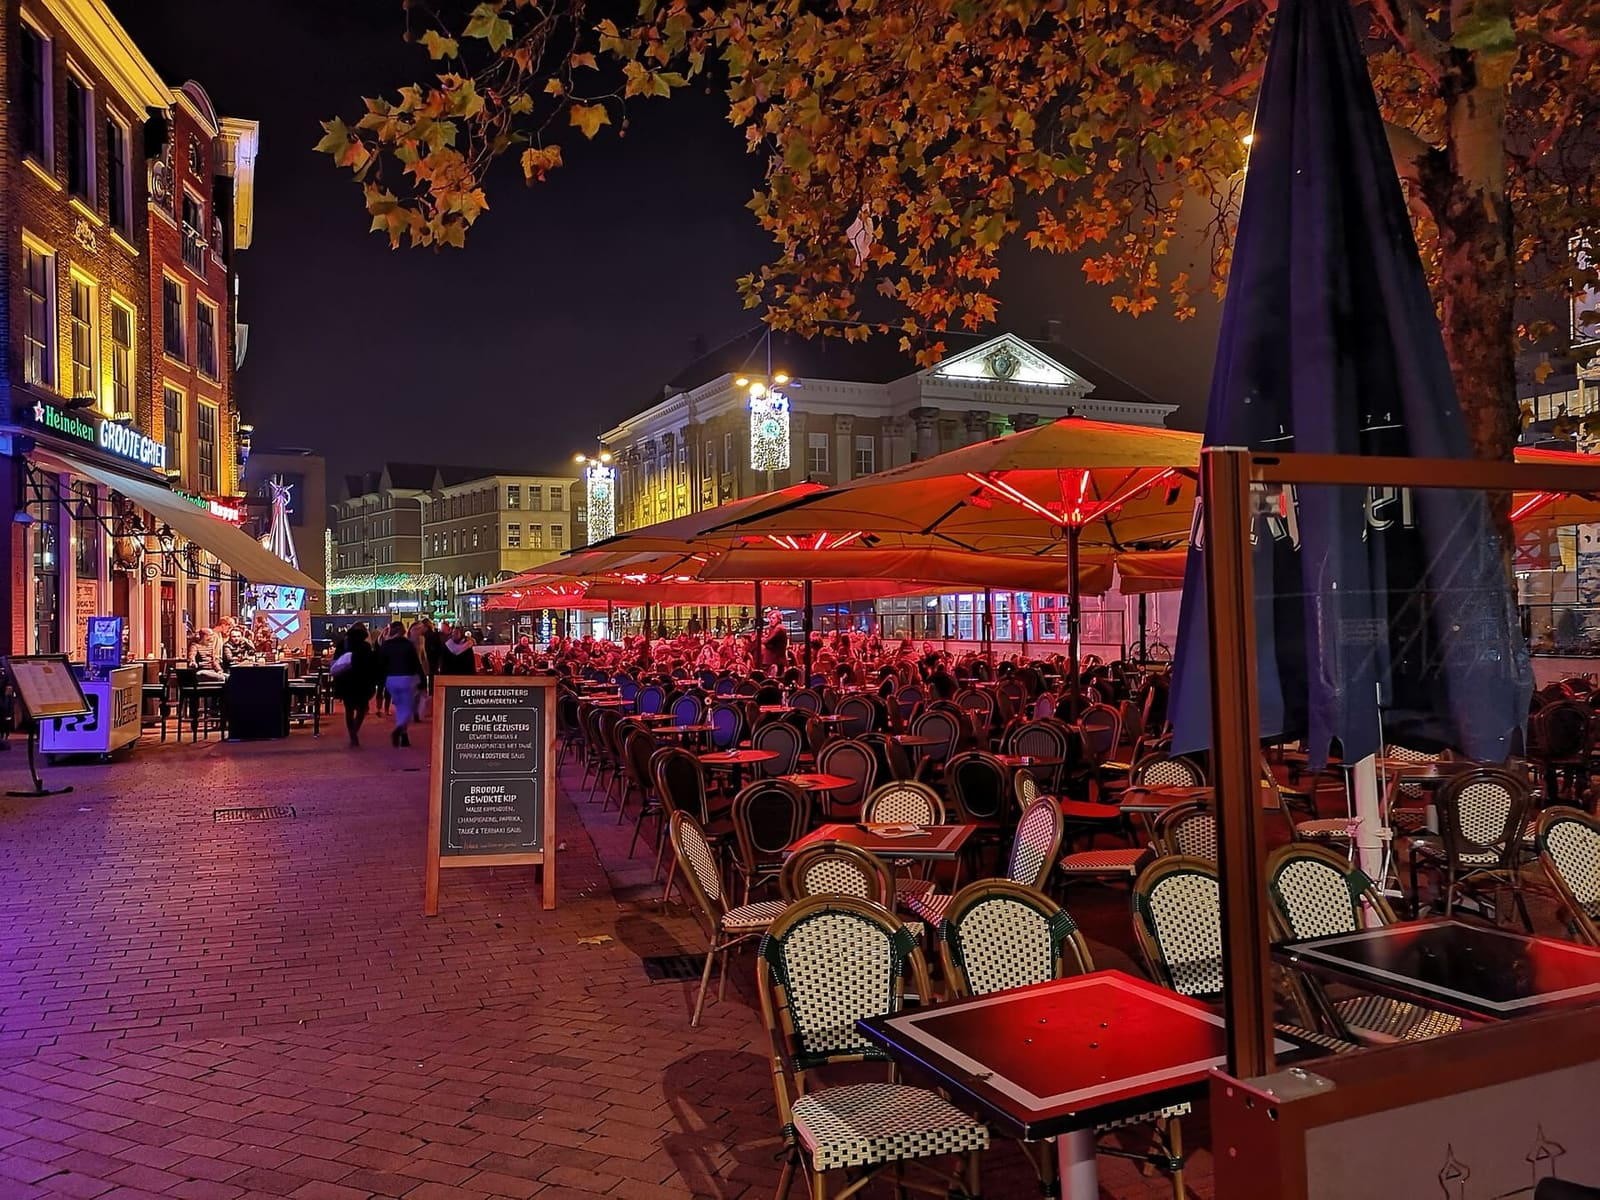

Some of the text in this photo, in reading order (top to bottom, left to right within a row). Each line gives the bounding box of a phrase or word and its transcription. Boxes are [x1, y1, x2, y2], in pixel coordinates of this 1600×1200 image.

[45, 405, 94, 442] Heineken
[100, 419, 166, 469] GROOTE GRIET
[488, 689, 529, 697] GEZUSTERS
[475, 714, 508, 723] SALADE
[460, 723, 530, 732] DE DRIE GEZUSTERS
[470, 786, 505, 794] BROODJE
[464, 794, 517, 804] GEWOKTE KIP
